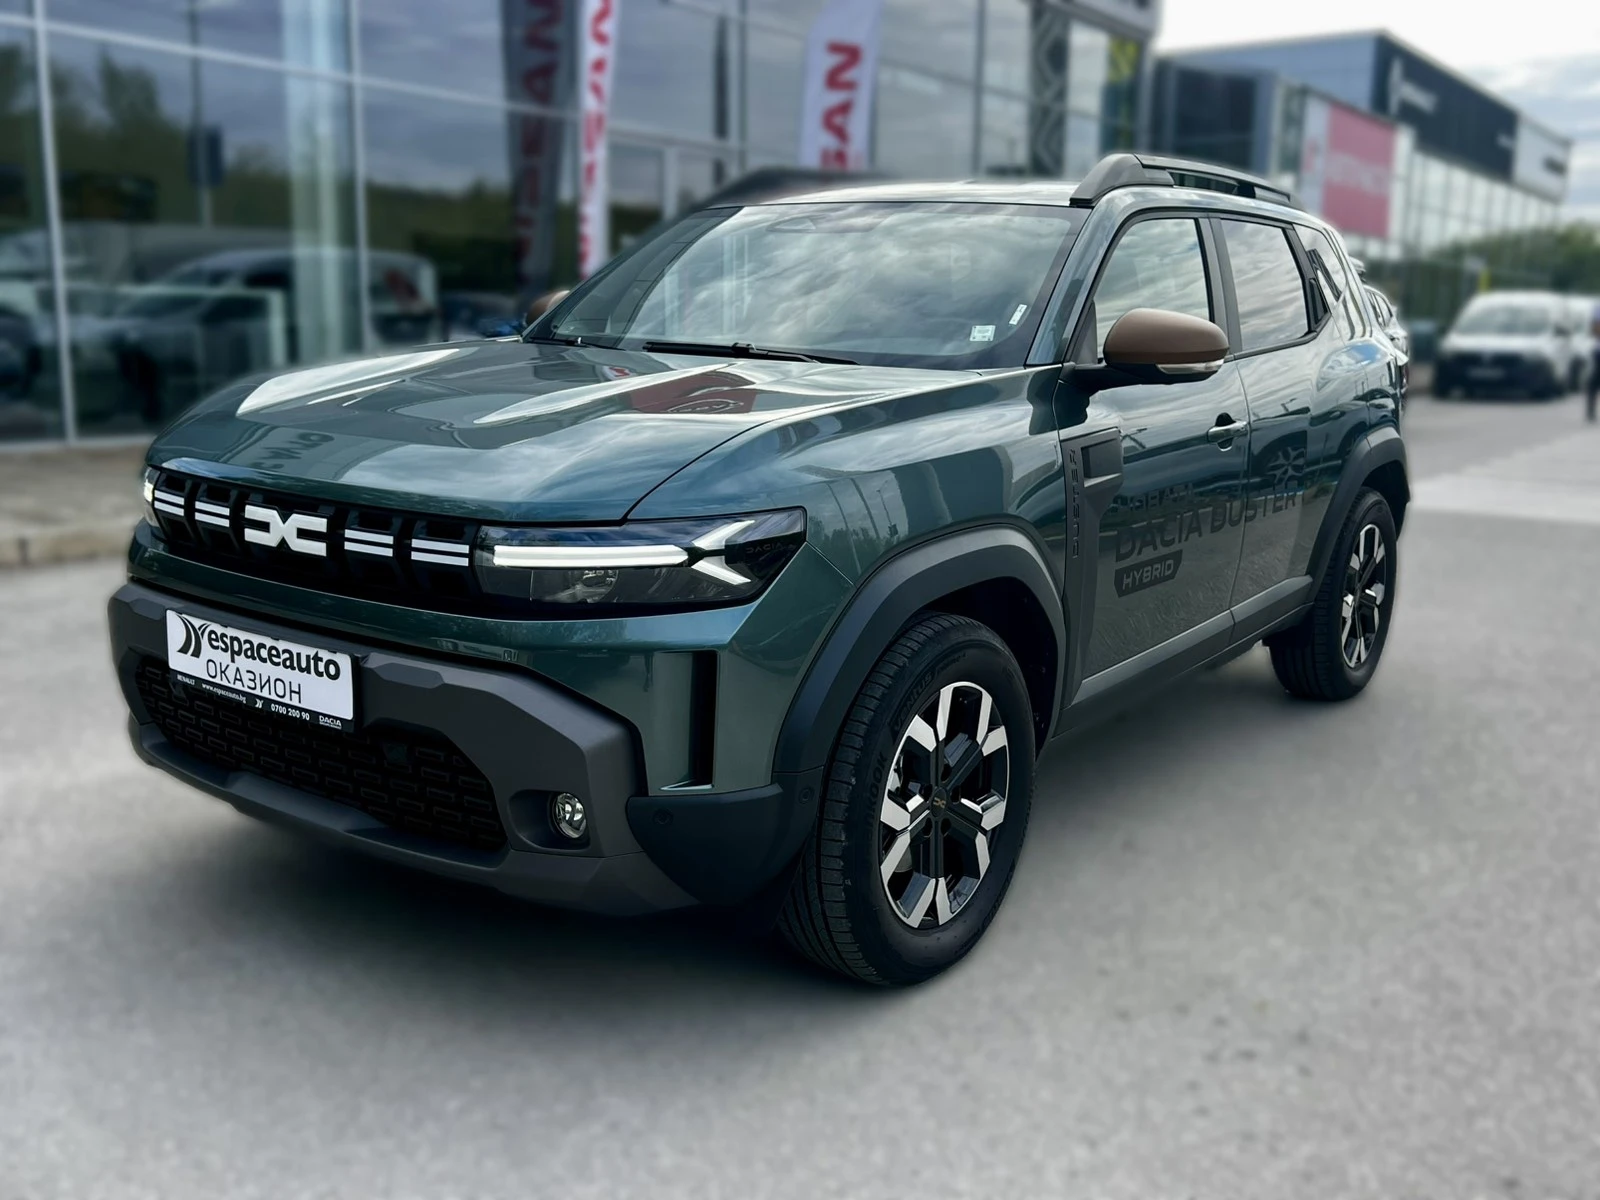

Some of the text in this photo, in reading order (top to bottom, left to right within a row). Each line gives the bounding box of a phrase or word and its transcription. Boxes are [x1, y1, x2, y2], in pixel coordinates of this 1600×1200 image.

[1115, 480, 1297, 563] DACIA DUSTER
[1122, 558, 1175, 591] HYBRID
[207, 629, 341, 681] espaceauto
[206, 658, 302, 704] ОКАЗИОН
[271, 703, 310, 721] 0700 200 90
[319, 715, 342, 727] DACIA
